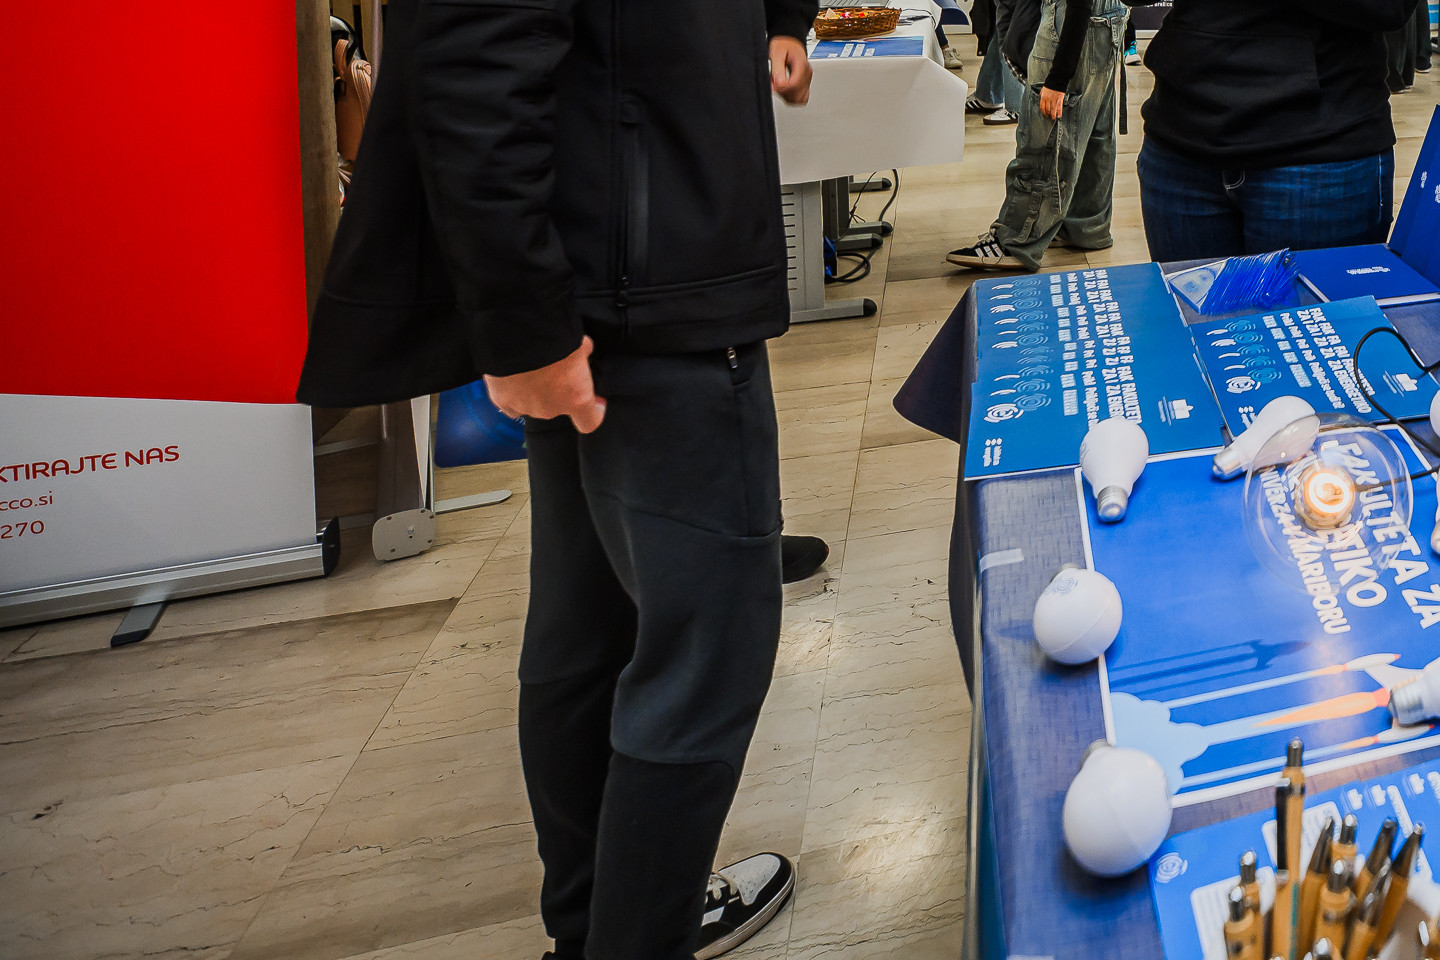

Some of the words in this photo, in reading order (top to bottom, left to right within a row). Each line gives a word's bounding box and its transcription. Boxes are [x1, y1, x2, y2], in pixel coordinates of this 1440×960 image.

[125, 445, 180, 468] NAS
[0, 520, 45, 539] 270
[1288, 535, 1351, 635] MARIBORU
